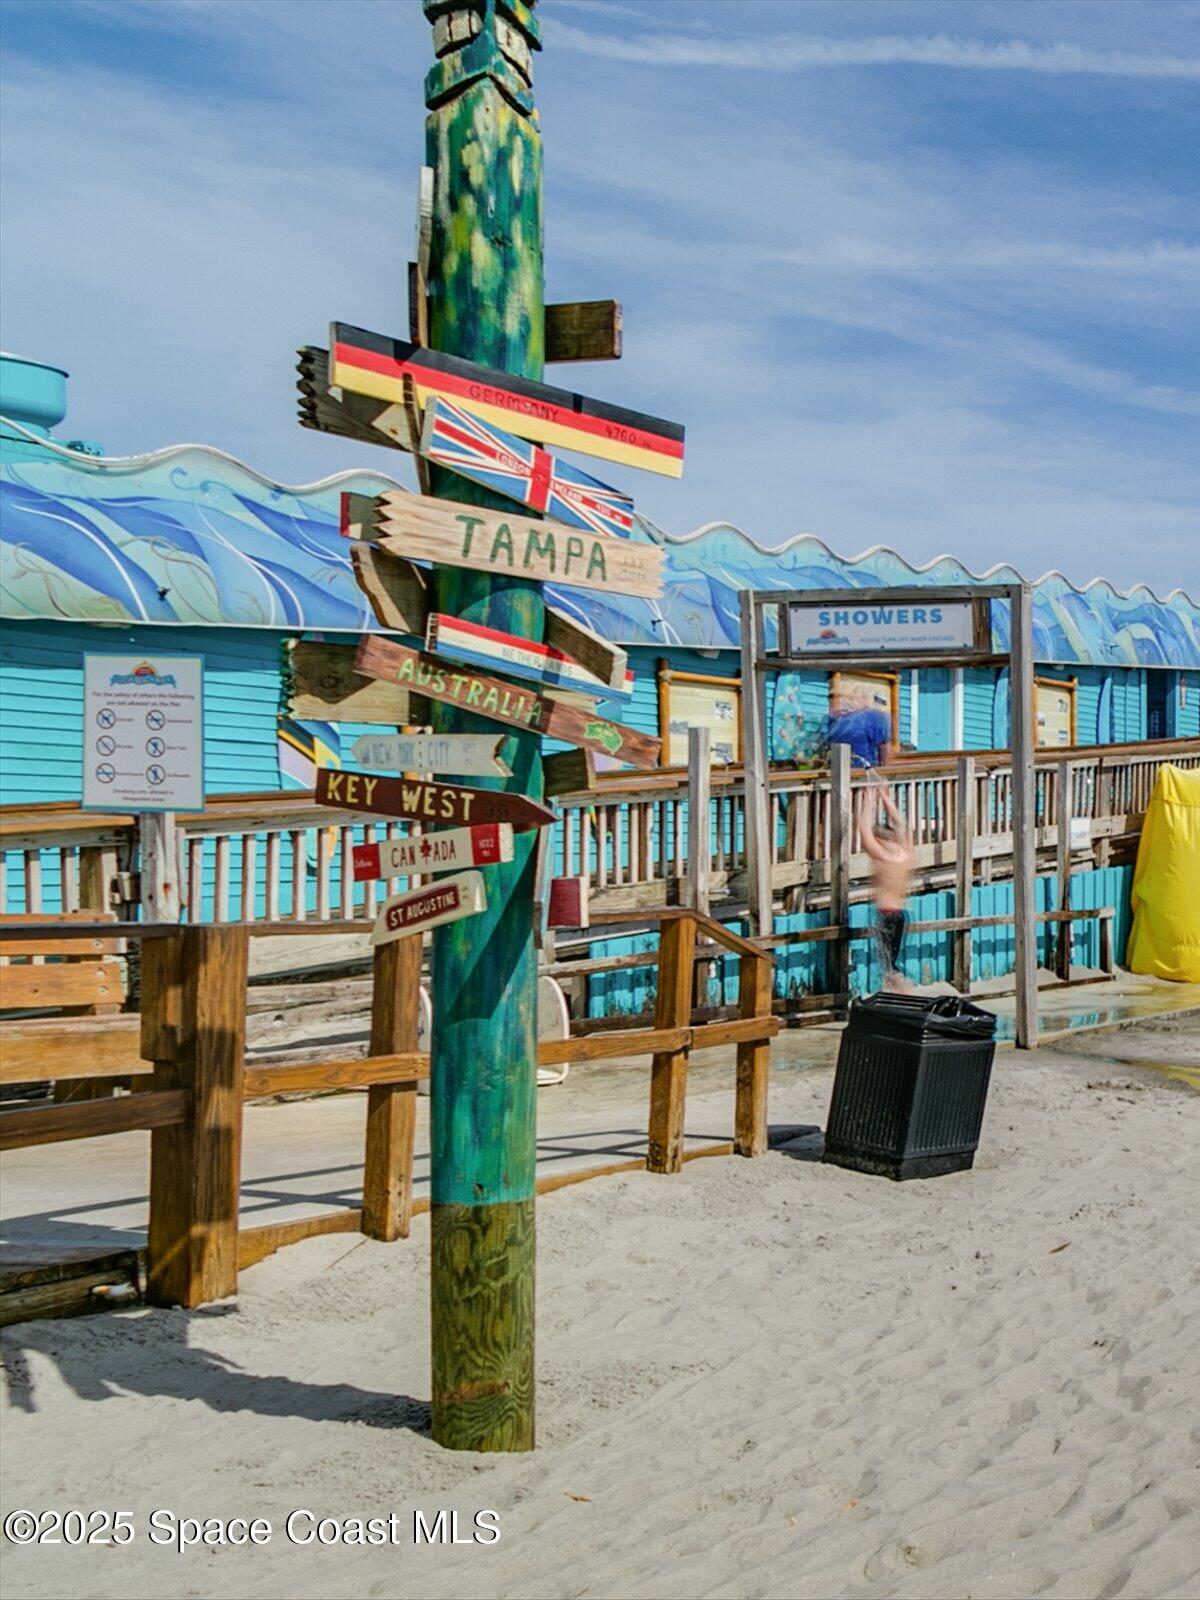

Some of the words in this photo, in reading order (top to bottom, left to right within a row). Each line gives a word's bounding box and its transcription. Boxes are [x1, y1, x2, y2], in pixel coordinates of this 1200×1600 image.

[468, 384, 559, 424] GERMANY
[495, 451, 532, 477] LONDON
[549, 480, 583, 504] ENGLAND
[455, 514, 608, 582] TAMPA
[818, 608, 943, 626] SHOWERS
[501, 646, 574, 677] NETHERLANDS
[396, 656, 543, 726] AUSTRALIA
[427, 741, 450, 767] CITY
[327, 772, 379, 808] KEY
[401, 784, 476, 821] WEST
[389, 908, 405, 927] ST
[406, 890, 457, 921] AUGUSTINE
